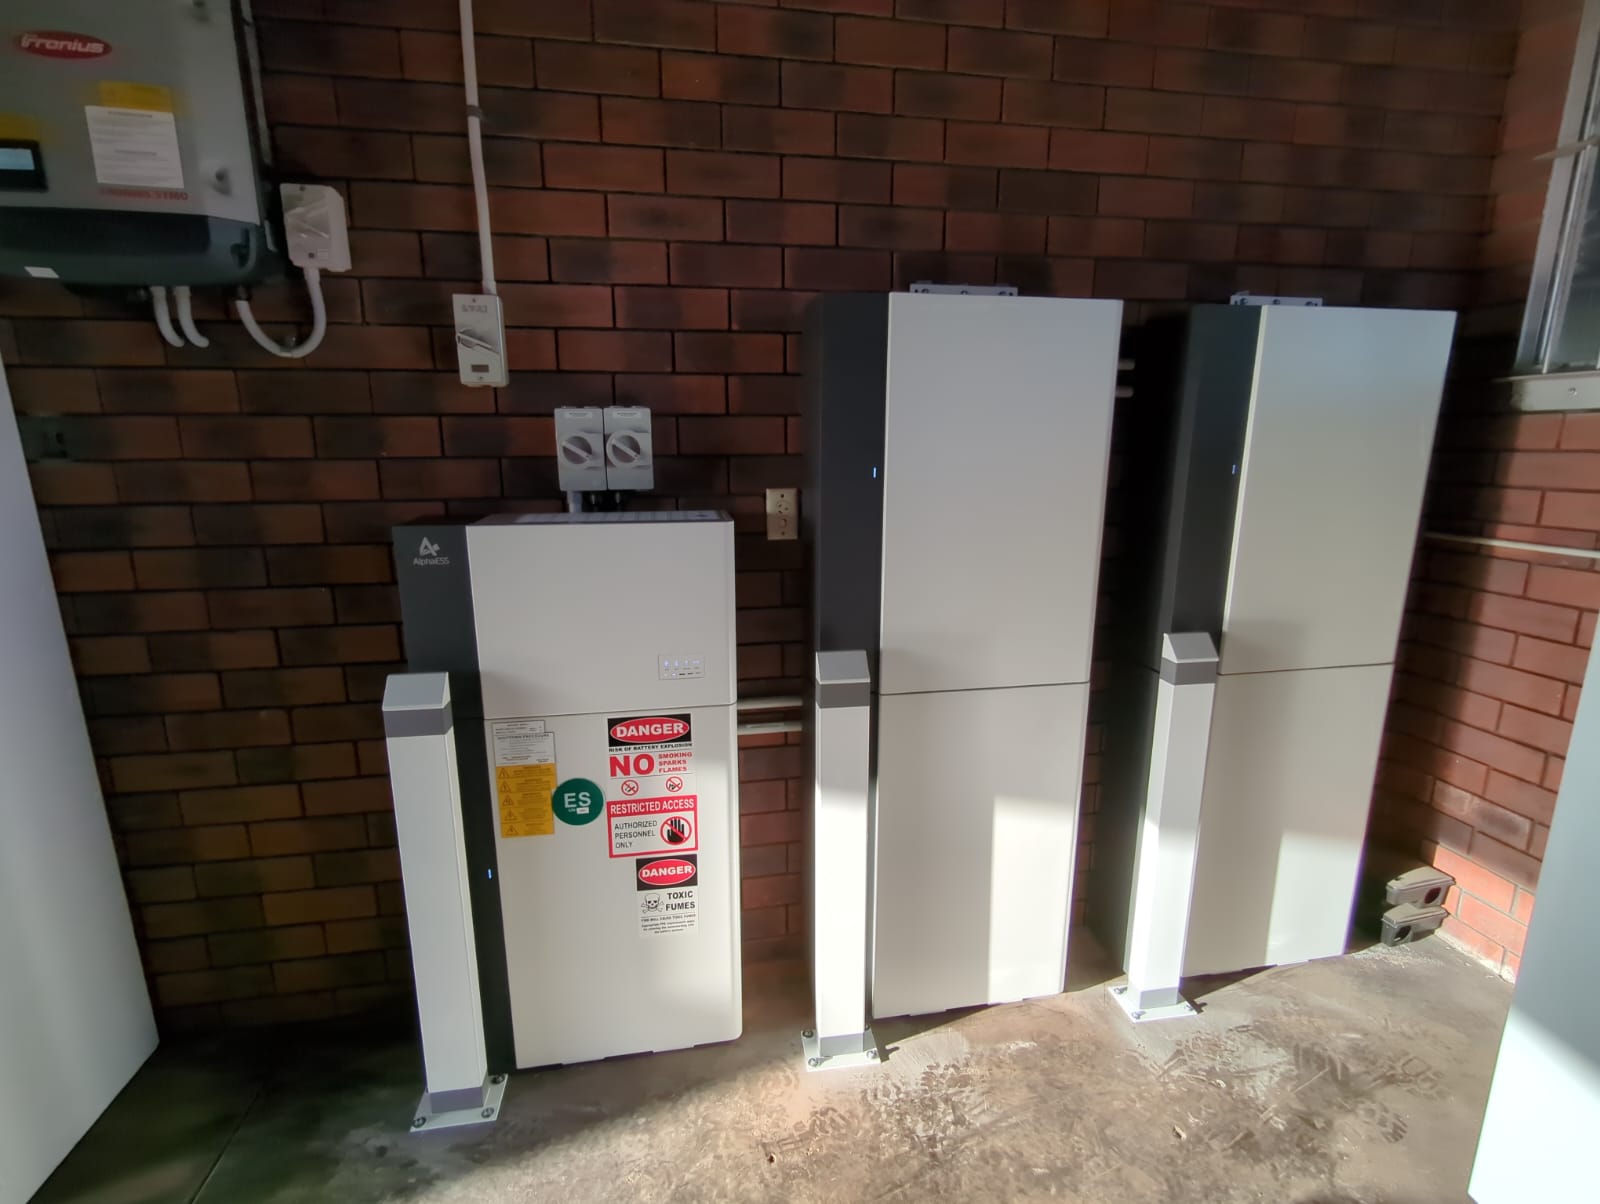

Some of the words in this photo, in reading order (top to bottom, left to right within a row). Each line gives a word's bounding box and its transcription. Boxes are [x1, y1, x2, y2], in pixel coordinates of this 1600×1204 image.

[413, 557, 450, 566] AlphaESS
[616, 723, 684, 737] DANGER
[658, 751, 693, 759] SMOKING
[609, 753, 655, 777] NO
[564, 791, 592, 808] ES
[610, 801, 661, 815] RESTRICTED
[662, 798, 695, 810] ACCESS
[614, 820, 658, 830] AUTHORIZED
[614, 830, 657, 839] PERSONNEL
[641, 865, 693, 878] DANGER
[666, 890, 694, 900] TOXIC
[665, 901, 696, 911] FUMES
